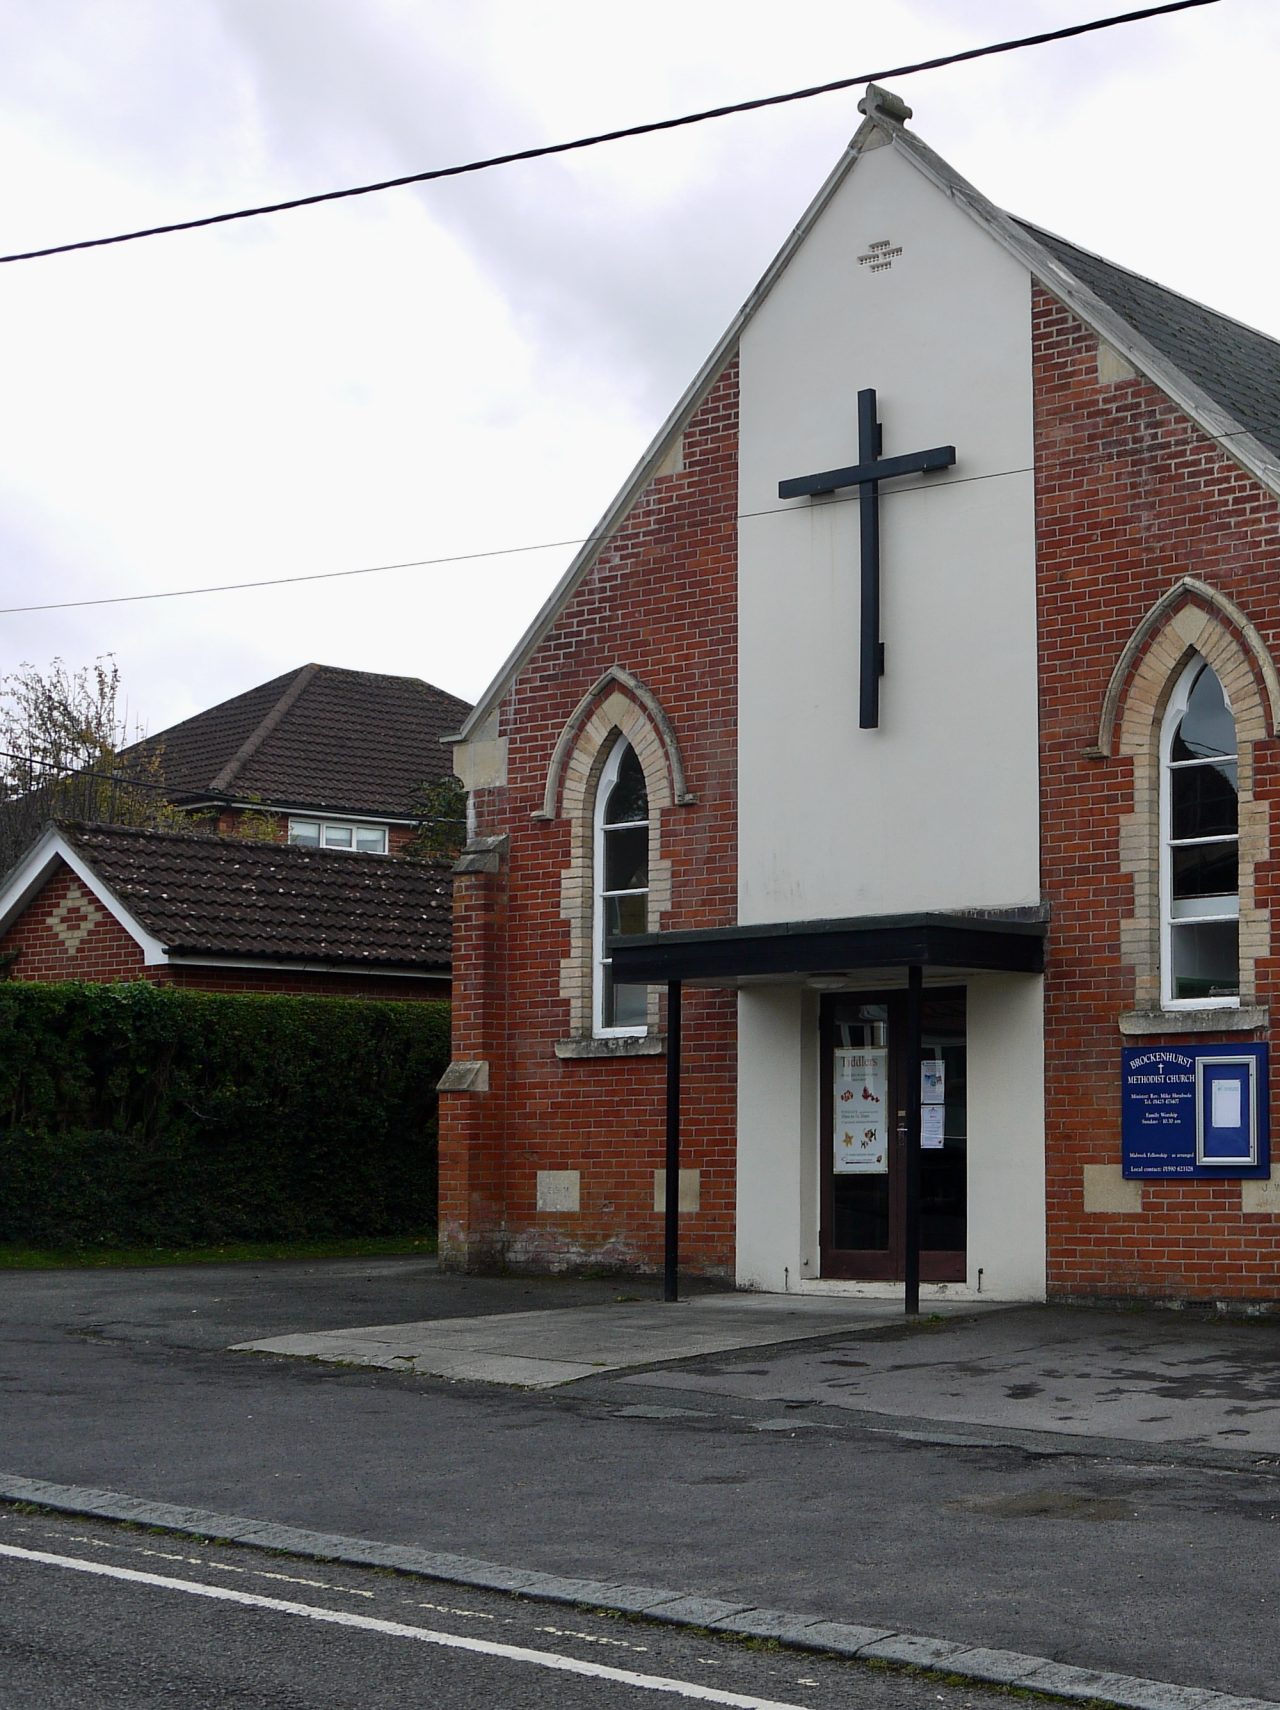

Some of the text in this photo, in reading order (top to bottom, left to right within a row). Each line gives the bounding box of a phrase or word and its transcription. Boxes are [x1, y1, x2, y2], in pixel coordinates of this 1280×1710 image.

[841, 1055, 878, 1067] Tiddlers
[1129, 1052, 1193, 1069] BROCKENHURST
[1128, 1074, 1195, 1084] METHODIST CHURCH
